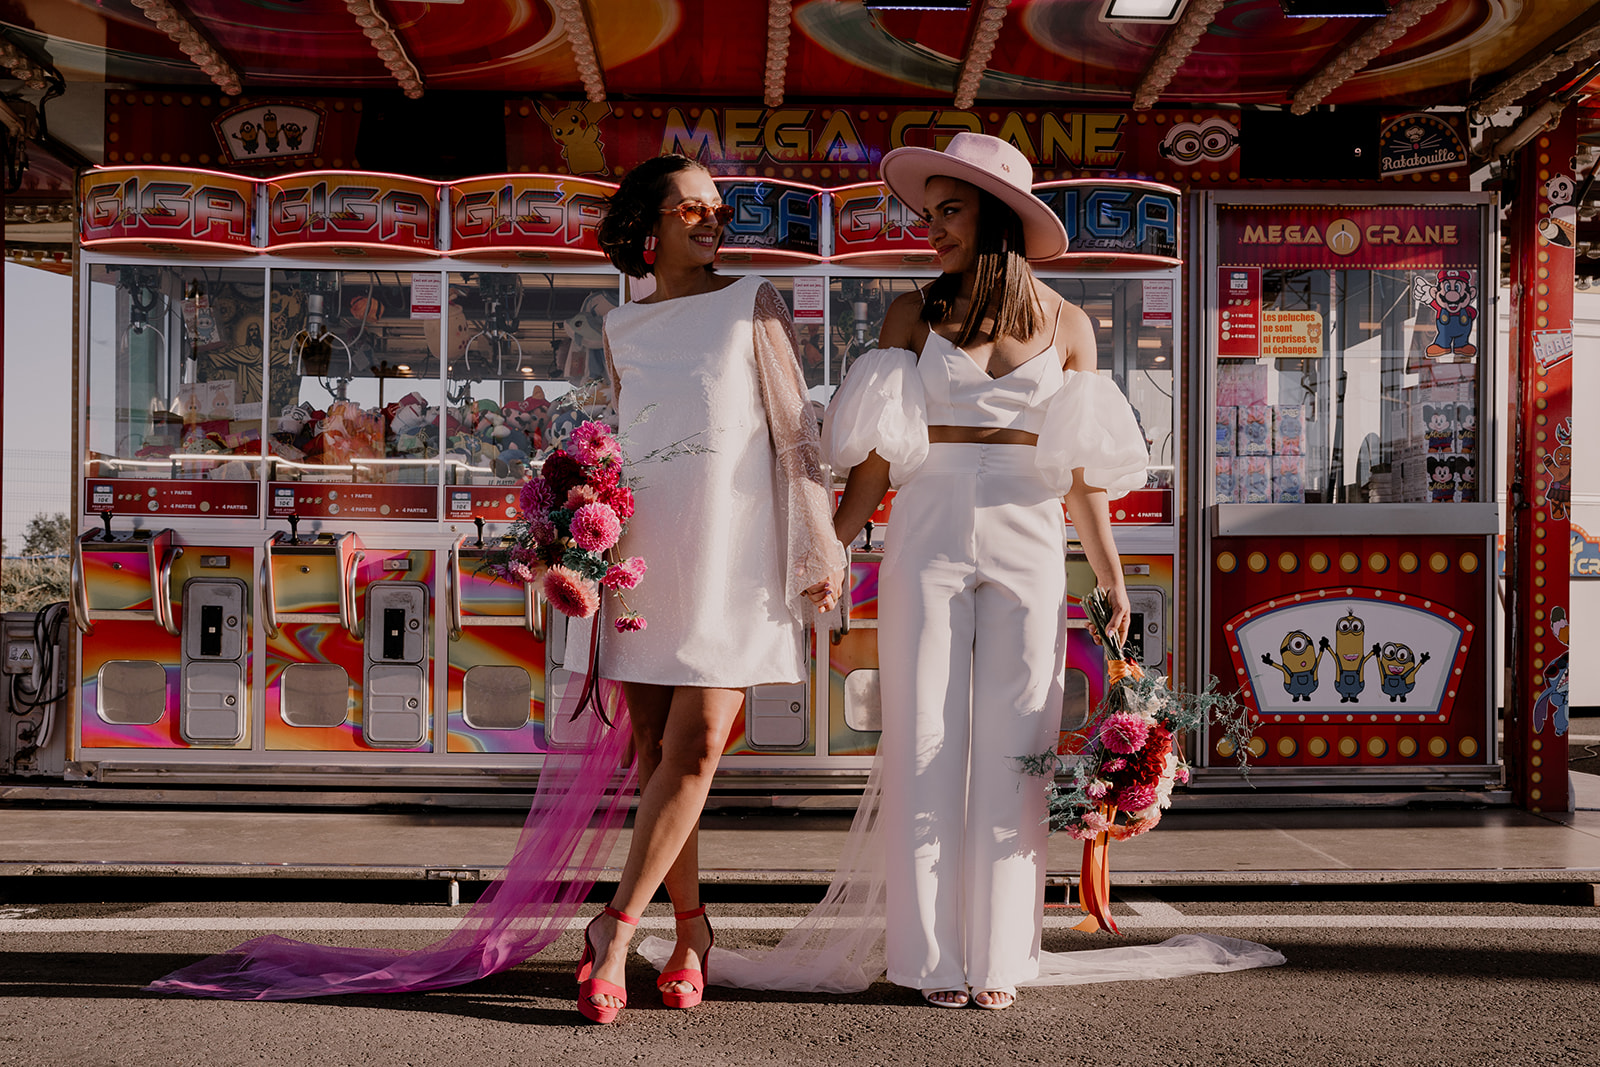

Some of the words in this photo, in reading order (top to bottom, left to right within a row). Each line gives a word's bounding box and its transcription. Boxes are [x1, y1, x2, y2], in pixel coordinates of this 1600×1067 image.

[661, 107, 871, 164] MEGA
[1382, 148, 1456, 170] Ratatouille
[86, 175, 247, 237] GIGA
[271, 180, 431, 241] GIGA
[1242, 225, 1323, 244] MEGA
[1365, 225, 1458, 244] CRANE
[1263, 313, 1276, 322] Les
[1278, 313, 1315, 322] peluches
[1275, 324, 1292, 332] sont
[1263, 335, 1271, 343] ni
[1272, 335, 1306, 344] reprises
[1263, 346, 1271, 354] ni
[1273, 345, 1317, 355] échangées
